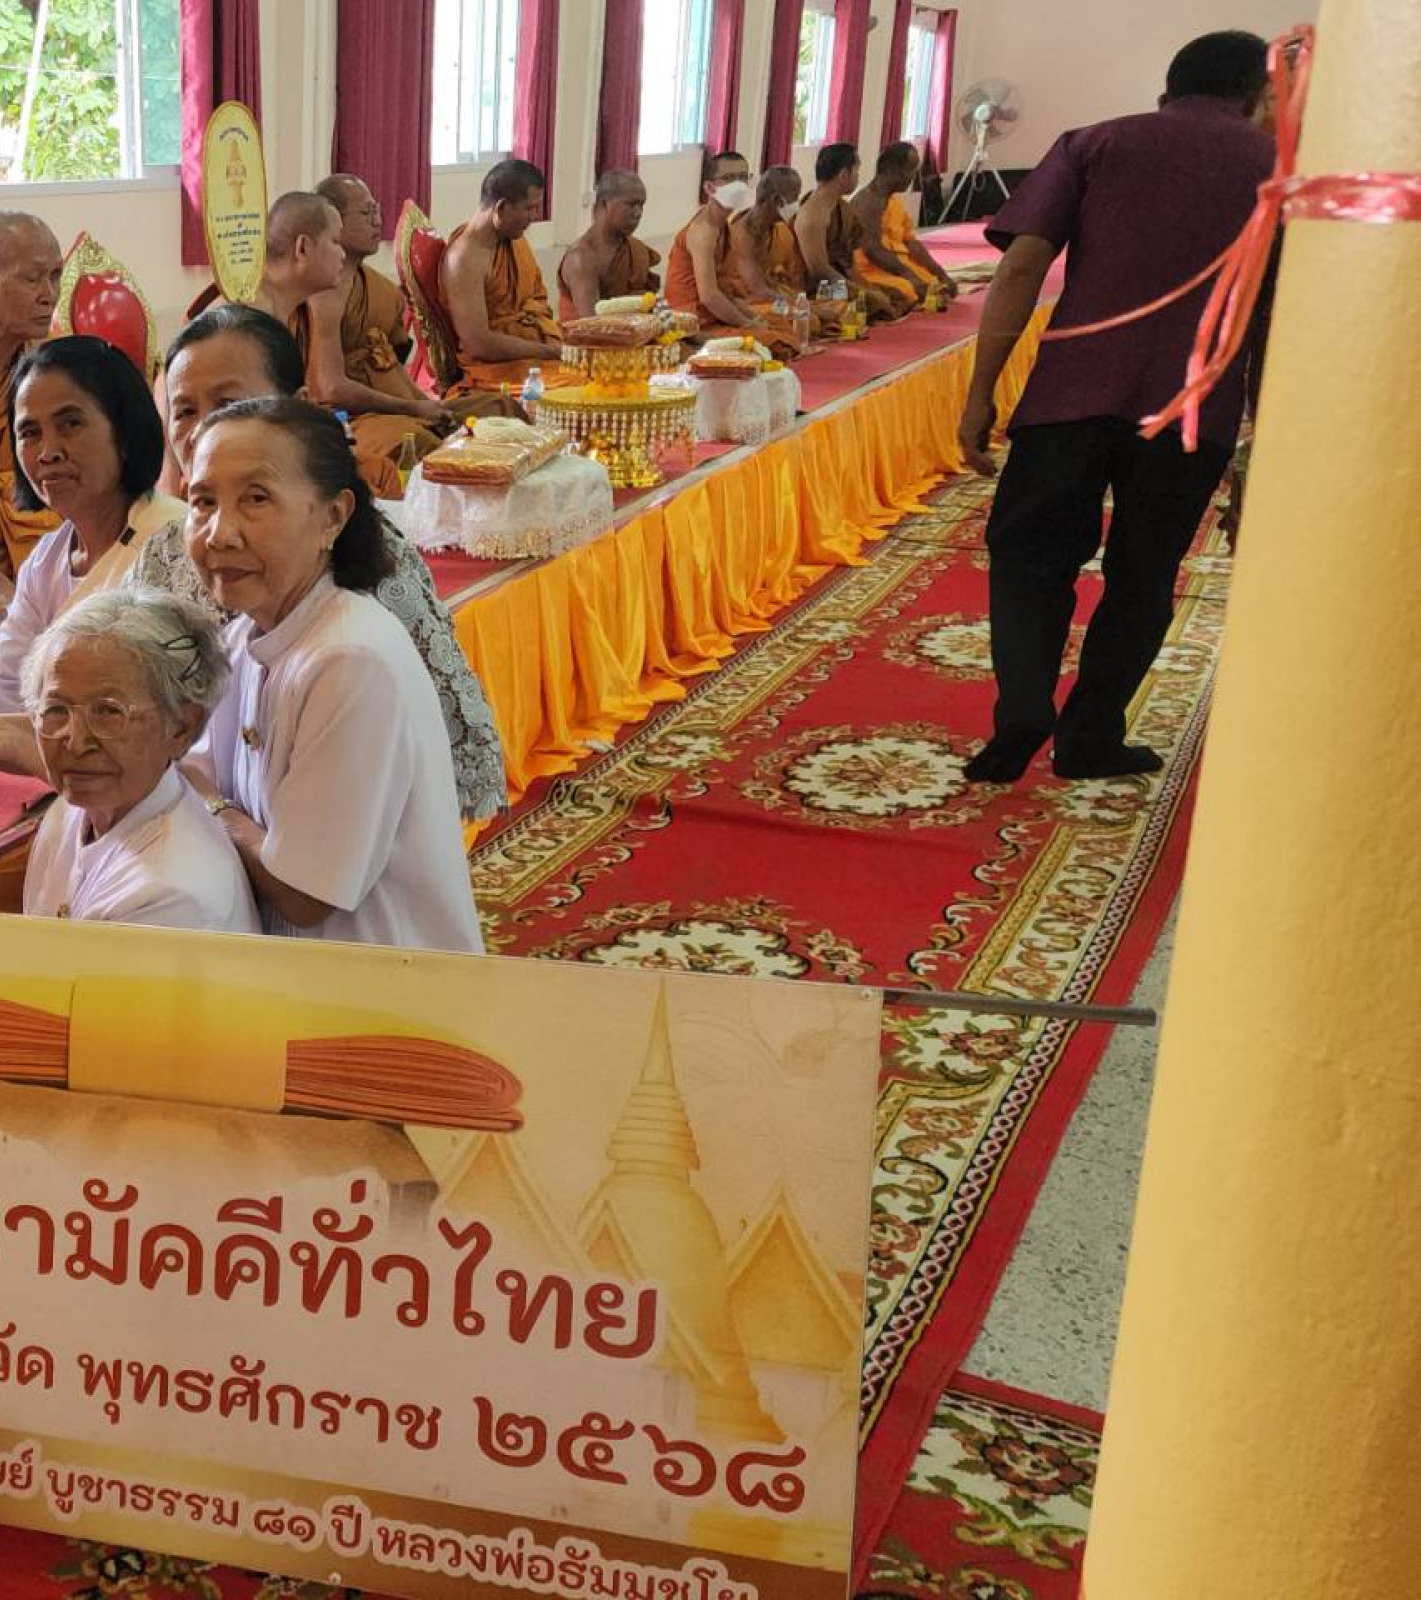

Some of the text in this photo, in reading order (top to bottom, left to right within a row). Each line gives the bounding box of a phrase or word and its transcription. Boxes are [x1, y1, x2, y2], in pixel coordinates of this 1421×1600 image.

[78, 1353, 441, 1451] พุทธศักราช
[474, 1395, 806, 1514] ๒๕๖๘
[46, 1467, 240, 1528] บูชาธรรม
[253, 1506, 316, 1543] ๘๑
[331, 1503, 363, 1549] ปี
